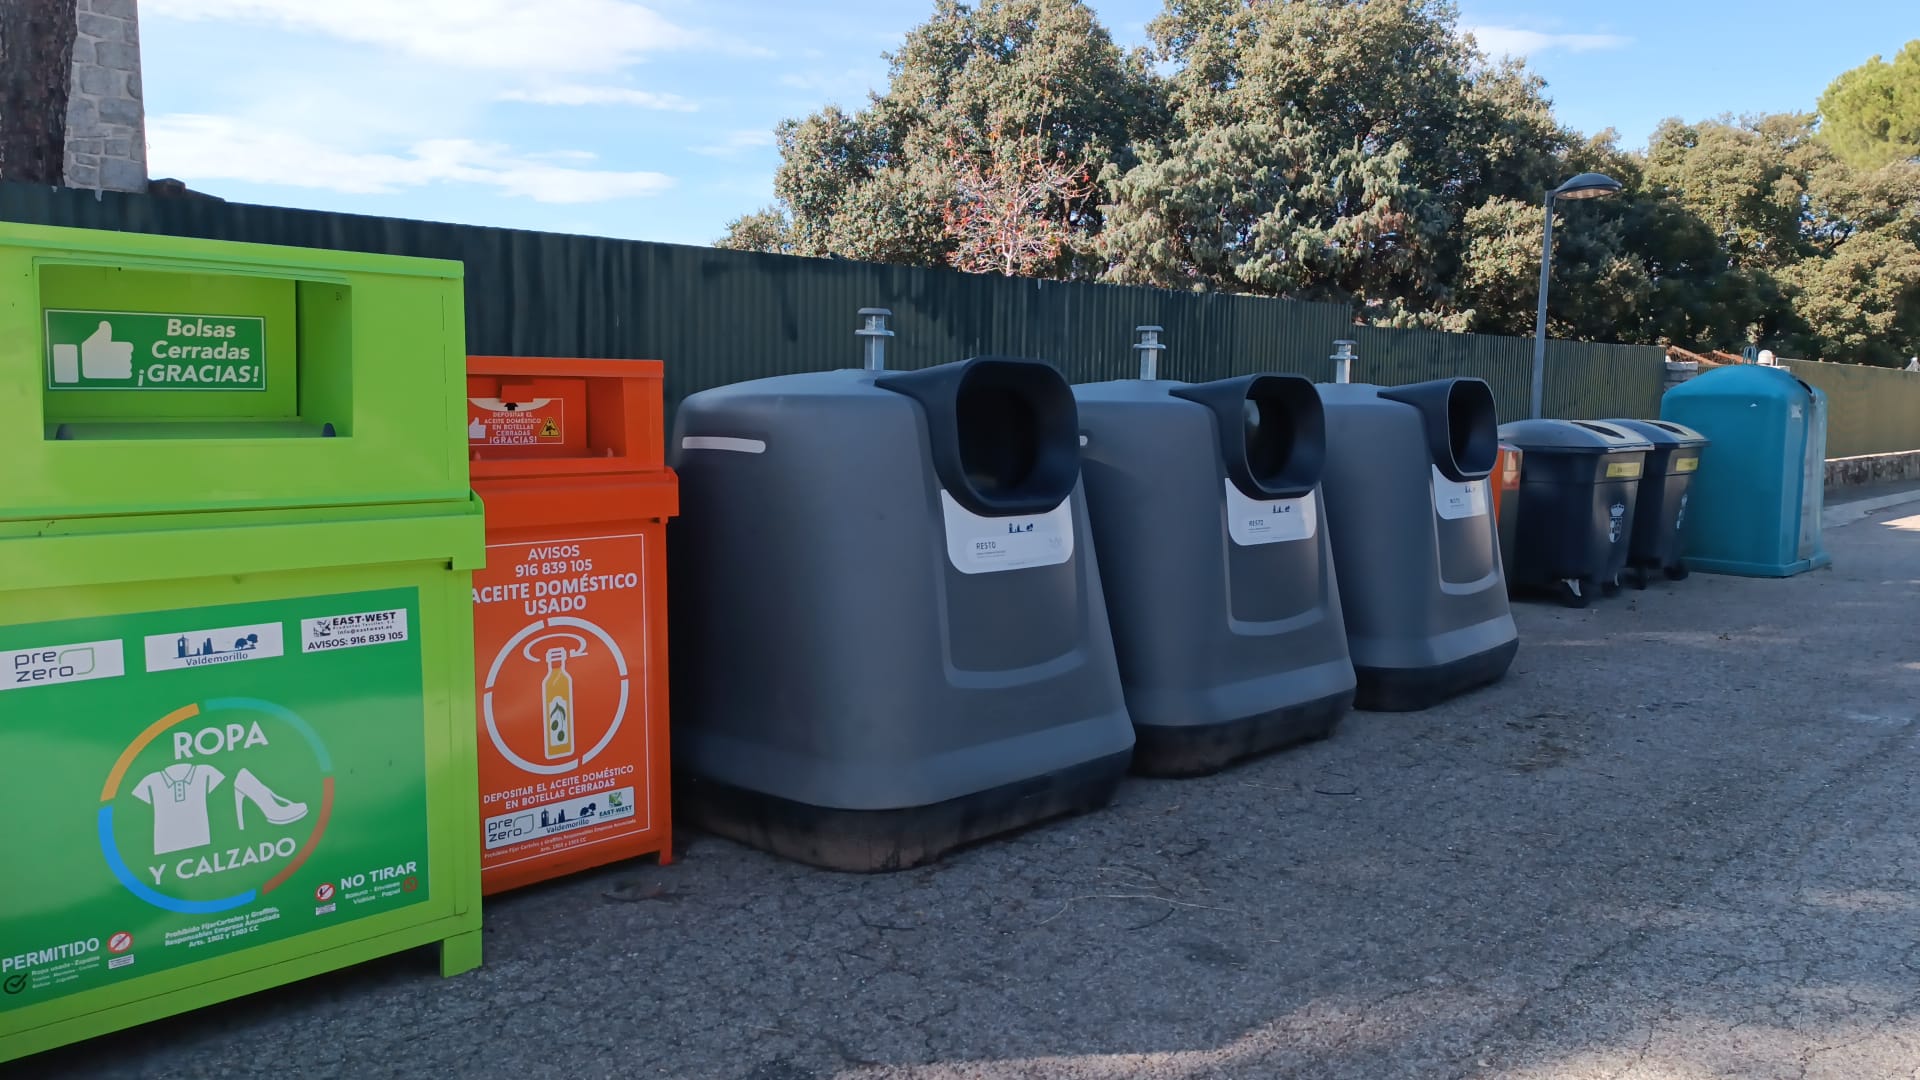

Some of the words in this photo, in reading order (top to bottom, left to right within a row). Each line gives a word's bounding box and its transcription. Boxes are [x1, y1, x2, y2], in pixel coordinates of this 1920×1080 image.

[167, 318, 236, 338] Bolsas
[152, 340, 250, 360] Cerradas
[138, 365, 259, 386] ¡GRACIAS!
[528, 545, 580, 560] AVISOS
[976, 542, 996, 550] RESTO
[515, 564, 538, 577] 916
[542, 561, 566, 575] 839
[570, 559, 592, 572] 105
[535, 572, 638, 598] DOMÉSTICO
[525, 595, 586, 616] USADO
[308, 638, 348, 650] AVISOS:
[350, 636, 366, 645] 916
[368, 634, 386, 642] 839
[388, 632, 403, 640] 105
[14, 651, 56, 670] pre
[186, 652, 248, 666] Valdemorillo
[16, 665, 74, 682] zero
[174, 721, 268, 760] ROPA
[484, 786, 533, 804] DEPOSITAR
[537, 784, 547, 792] EL
[550, 776, 580, 789] ACEITE
[583, 765, 634, 783] DOMÉSTICO
[505, 799, 519, 810] EN
[522, 790, 565, 806] BOTELLAS
[569, 778, 615, 795] CERRADAS
[488, 828, 522, 842] zero
[489, 819, 512, 833] pre
[546, 819, 589, 833] Valdemorillo
[149, 864, 166, 885] Y
[175, 838, 296, 879] CALZADO
[341, 874, 365, 890] NO
[369, 861, 416, 882] TIRAR
[2, 938, 99, 973] PERMITIDO
